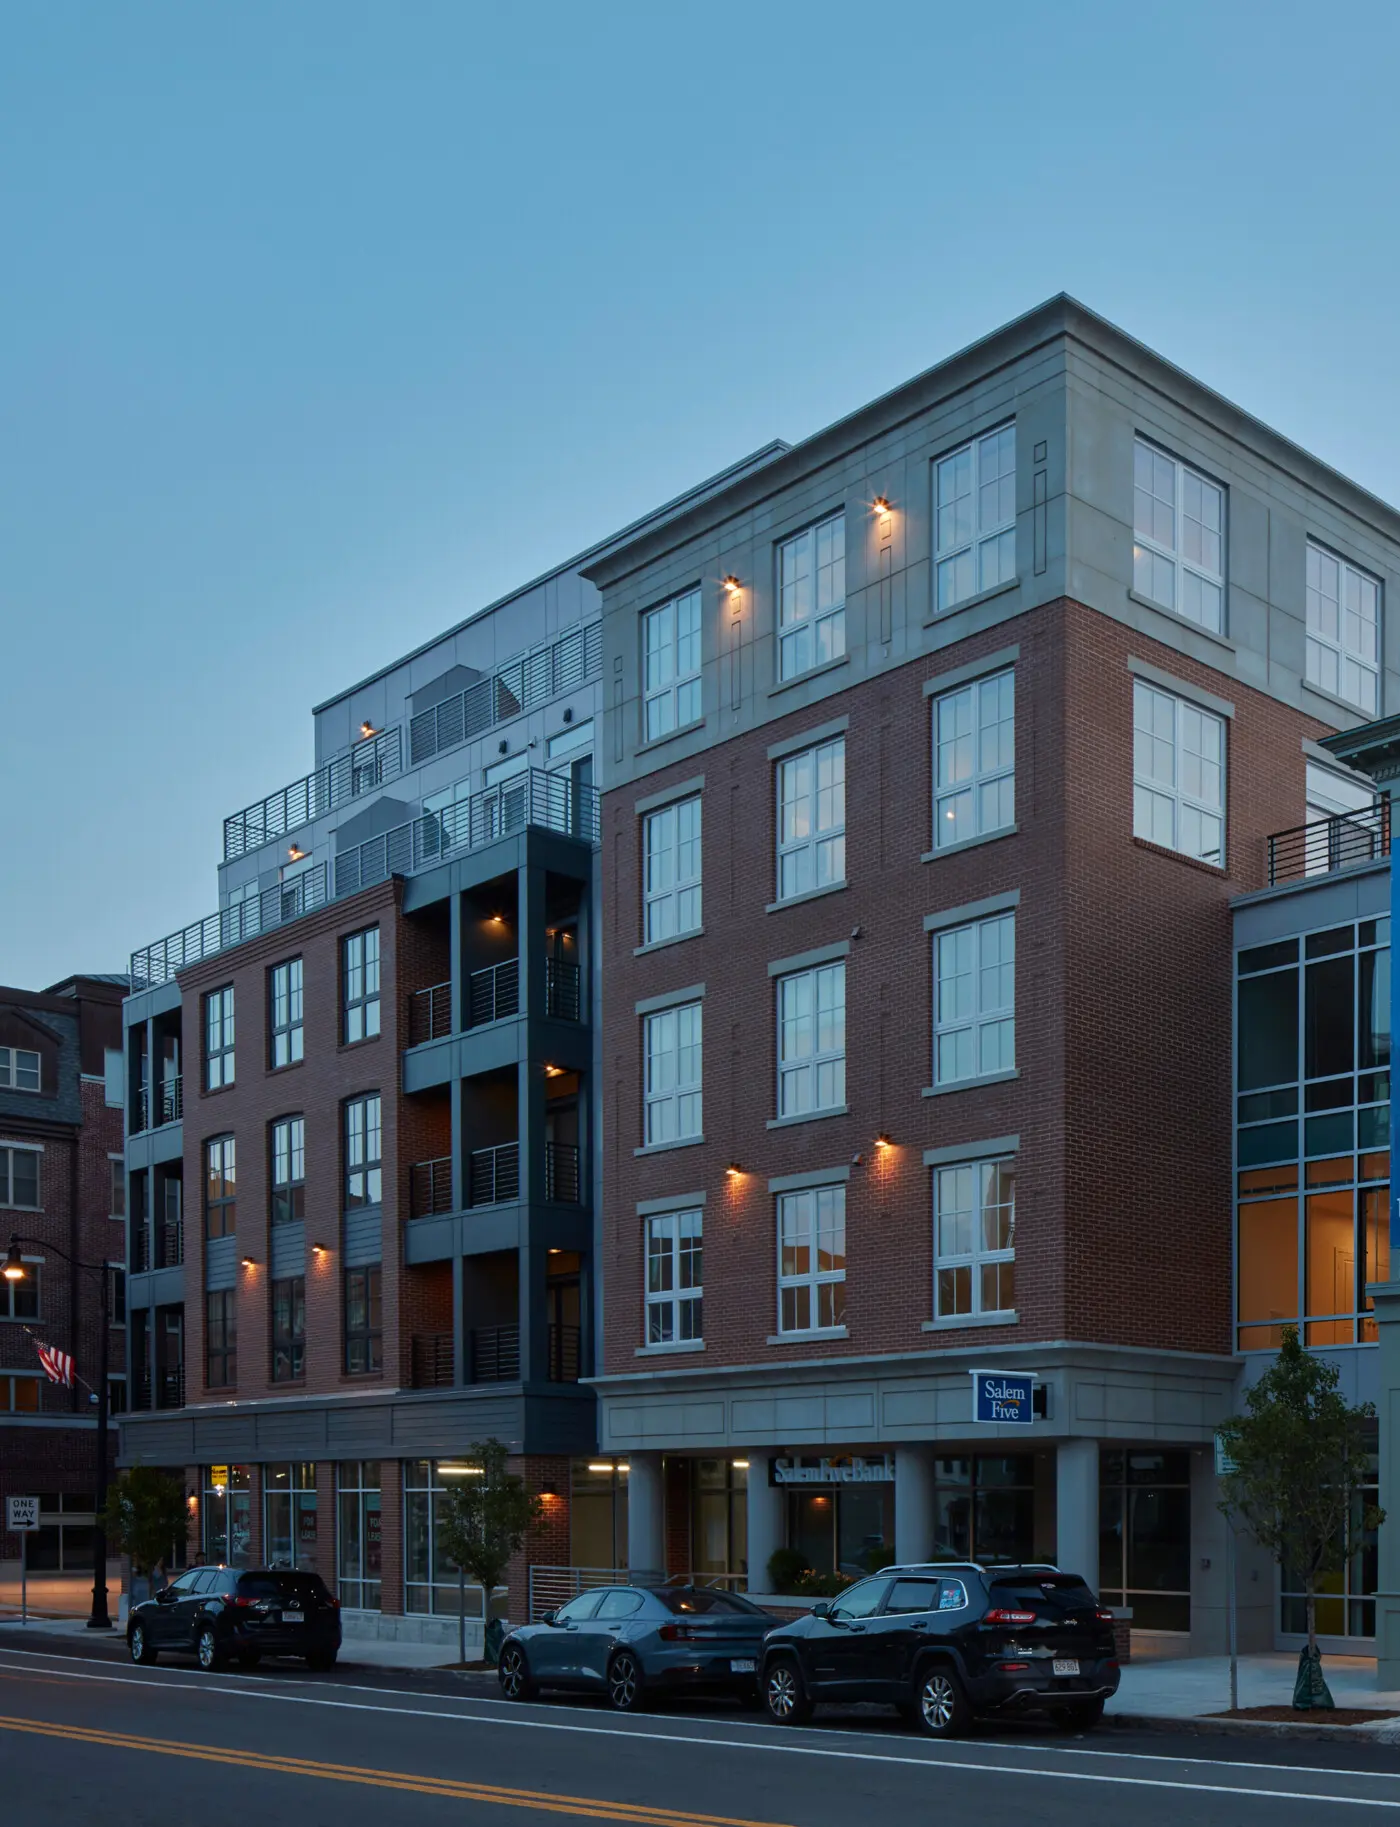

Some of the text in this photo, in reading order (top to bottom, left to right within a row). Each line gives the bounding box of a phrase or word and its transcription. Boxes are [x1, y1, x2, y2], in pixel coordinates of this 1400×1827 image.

[985, 1380, 1026, 1400] Salem
[991, 1400, 1019, 1420] Five
[13, 1499, 34, 1508] ONE
[13, 1510, 34, 1518] WAY
